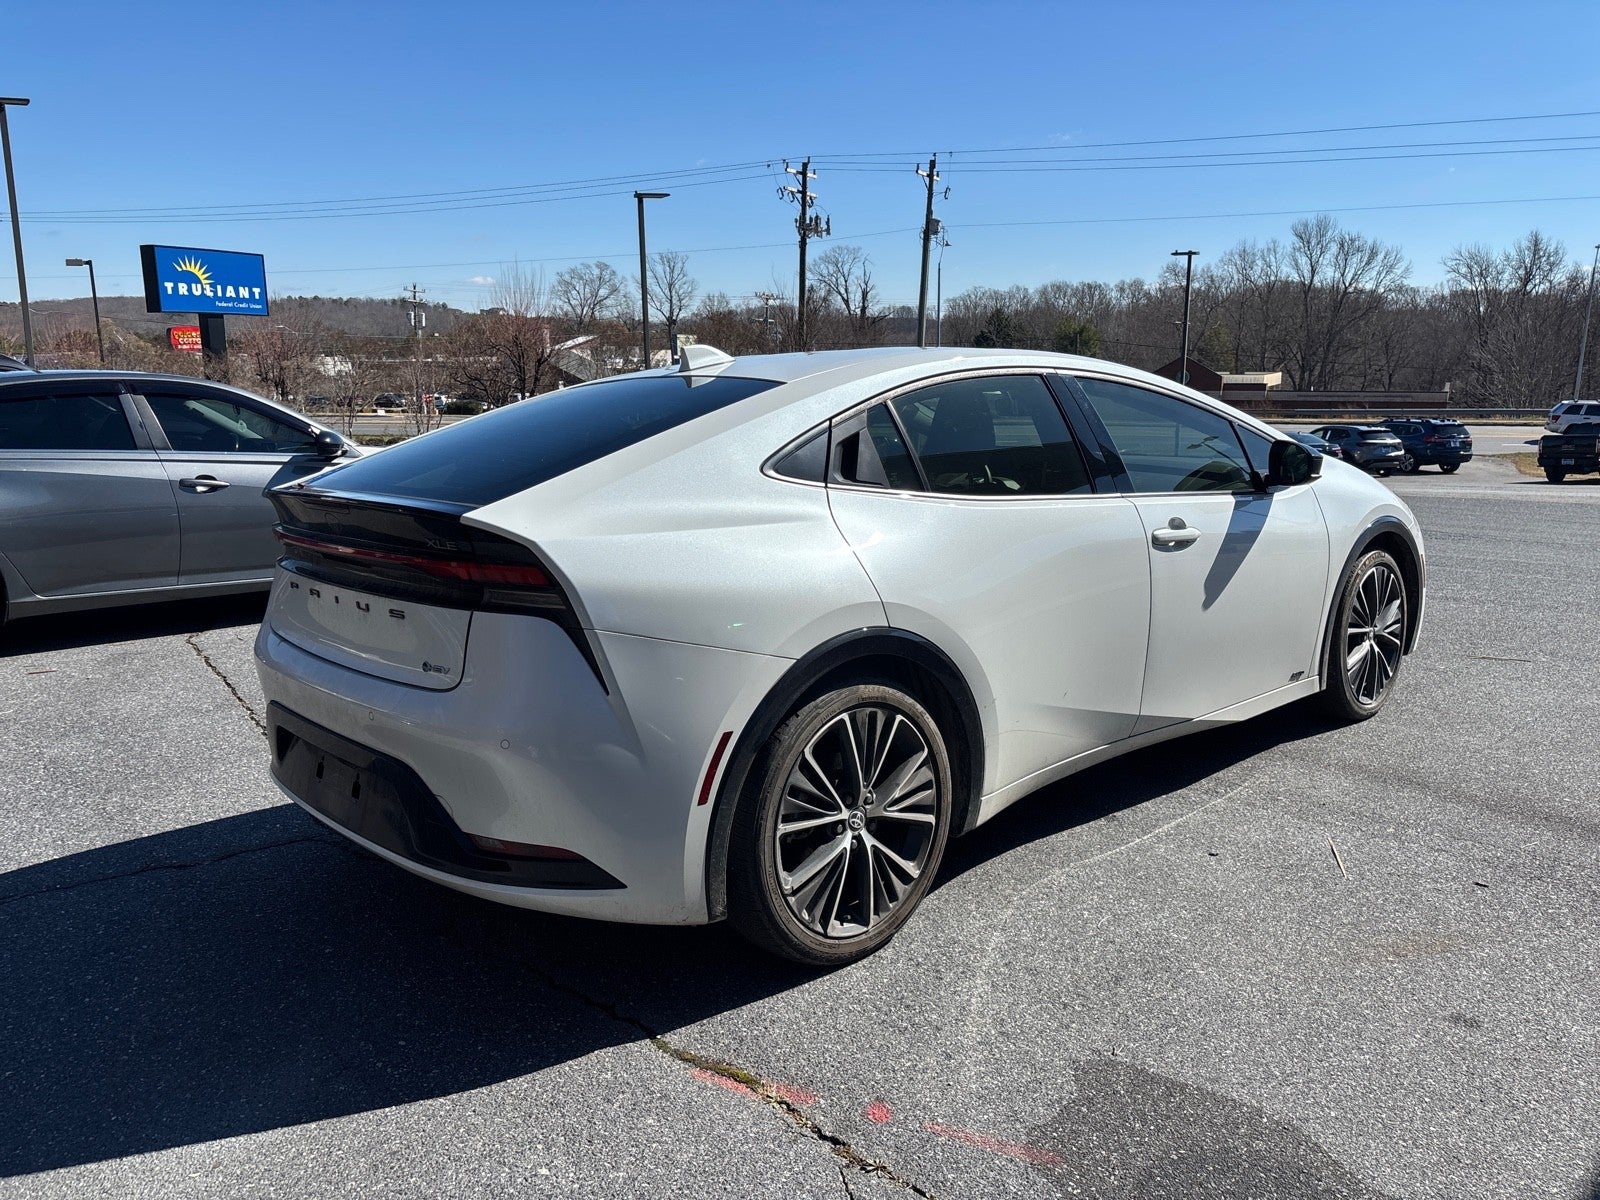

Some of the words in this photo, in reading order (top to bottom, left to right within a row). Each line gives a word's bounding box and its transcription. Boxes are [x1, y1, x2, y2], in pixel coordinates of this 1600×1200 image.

[164, 282, 261, 300] TRULIANT
[424, 538, 457, 551] XLE
[289, 581, 406, 620] PRIUS
